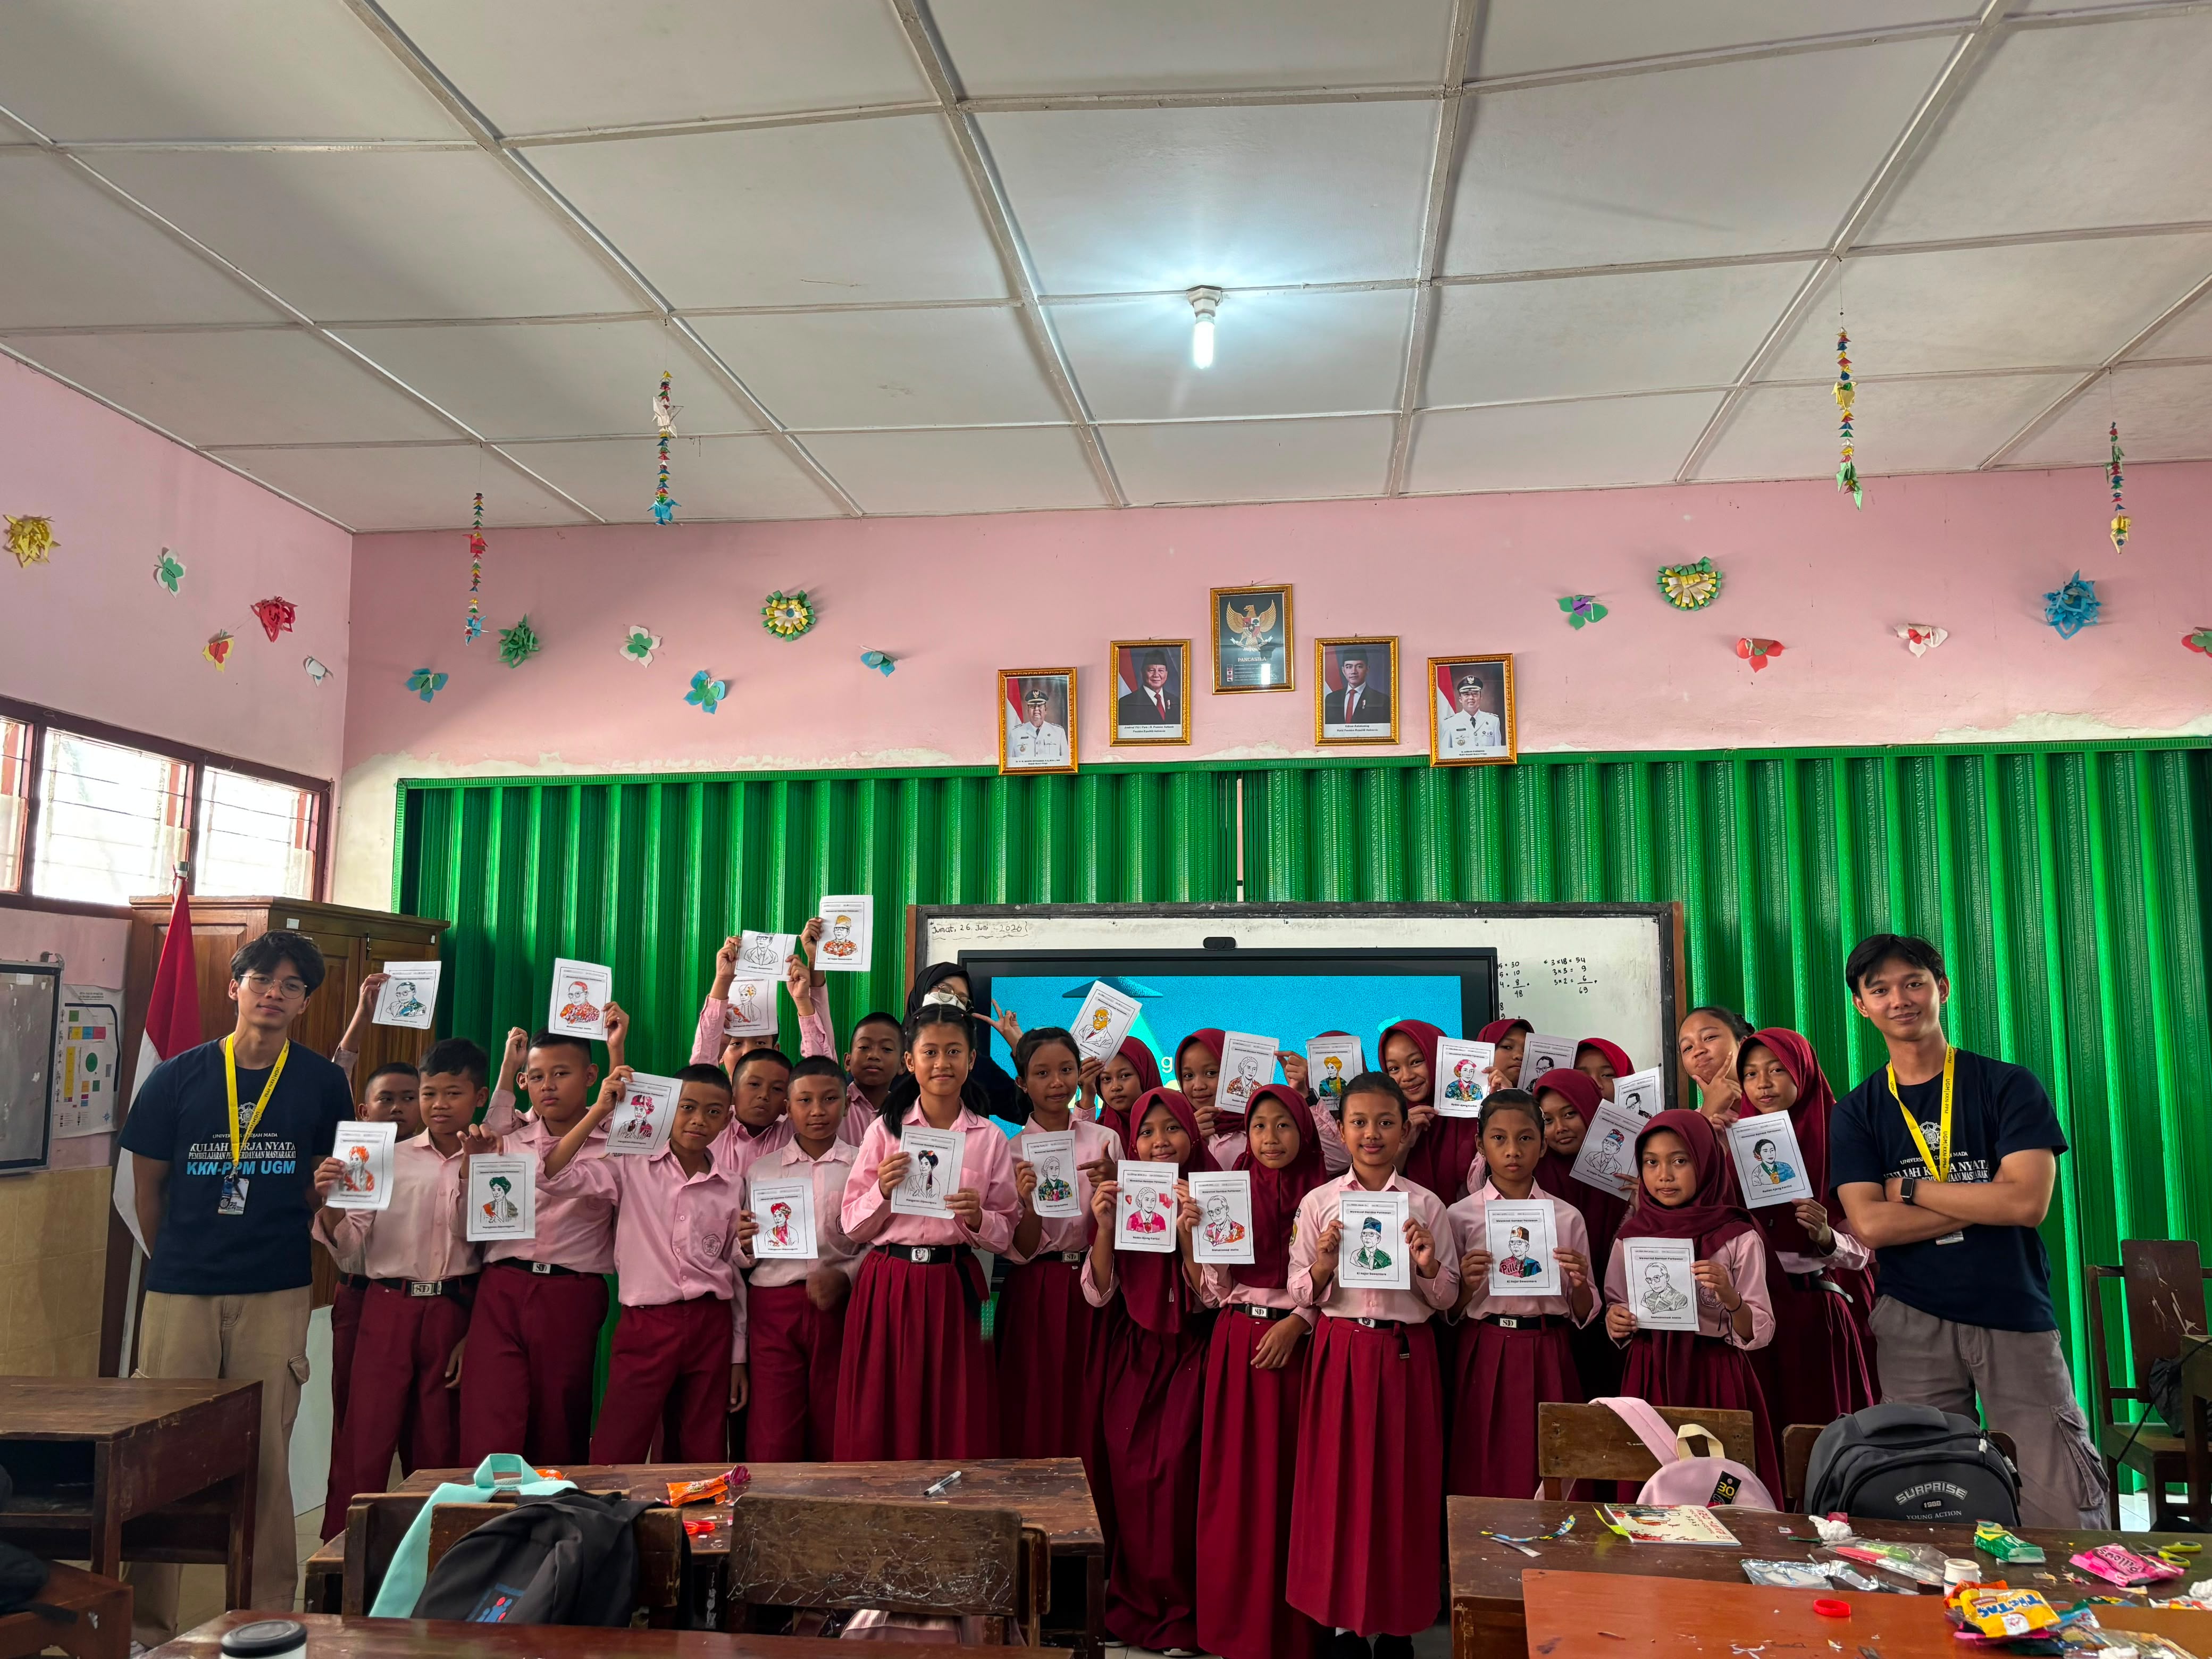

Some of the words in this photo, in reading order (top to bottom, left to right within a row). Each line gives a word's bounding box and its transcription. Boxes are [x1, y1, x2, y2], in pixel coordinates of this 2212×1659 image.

[261, 1160, 296, 1175] UGM
[1958, 1160, 1989, 1171] NYAT
[1717, 1481, 1735, 1496] 30
[1895, 1481, 1967, 1504] SURPRISE
[2097, 1548, 2141, 1574] Pillows
